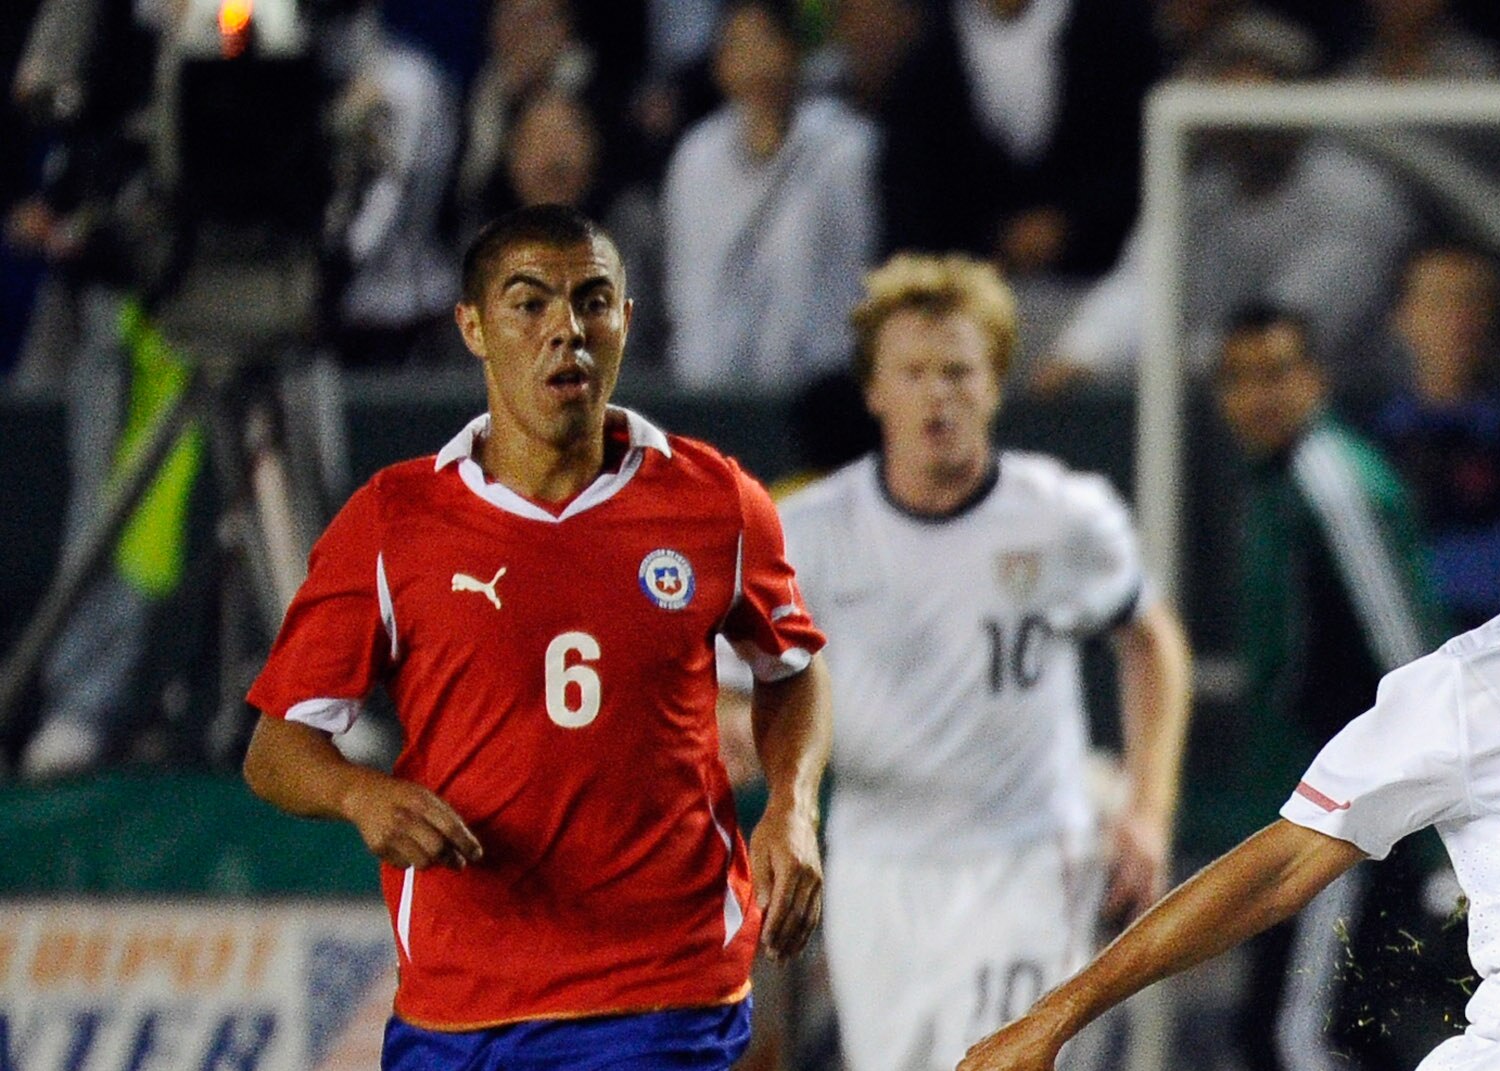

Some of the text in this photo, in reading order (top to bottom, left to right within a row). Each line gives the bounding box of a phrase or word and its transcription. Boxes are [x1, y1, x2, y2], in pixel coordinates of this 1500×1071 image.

[545, 630, 601, 729] 6
[984, 614, 1053, 690] 10
[974, 960, 1043, 1022] 10
